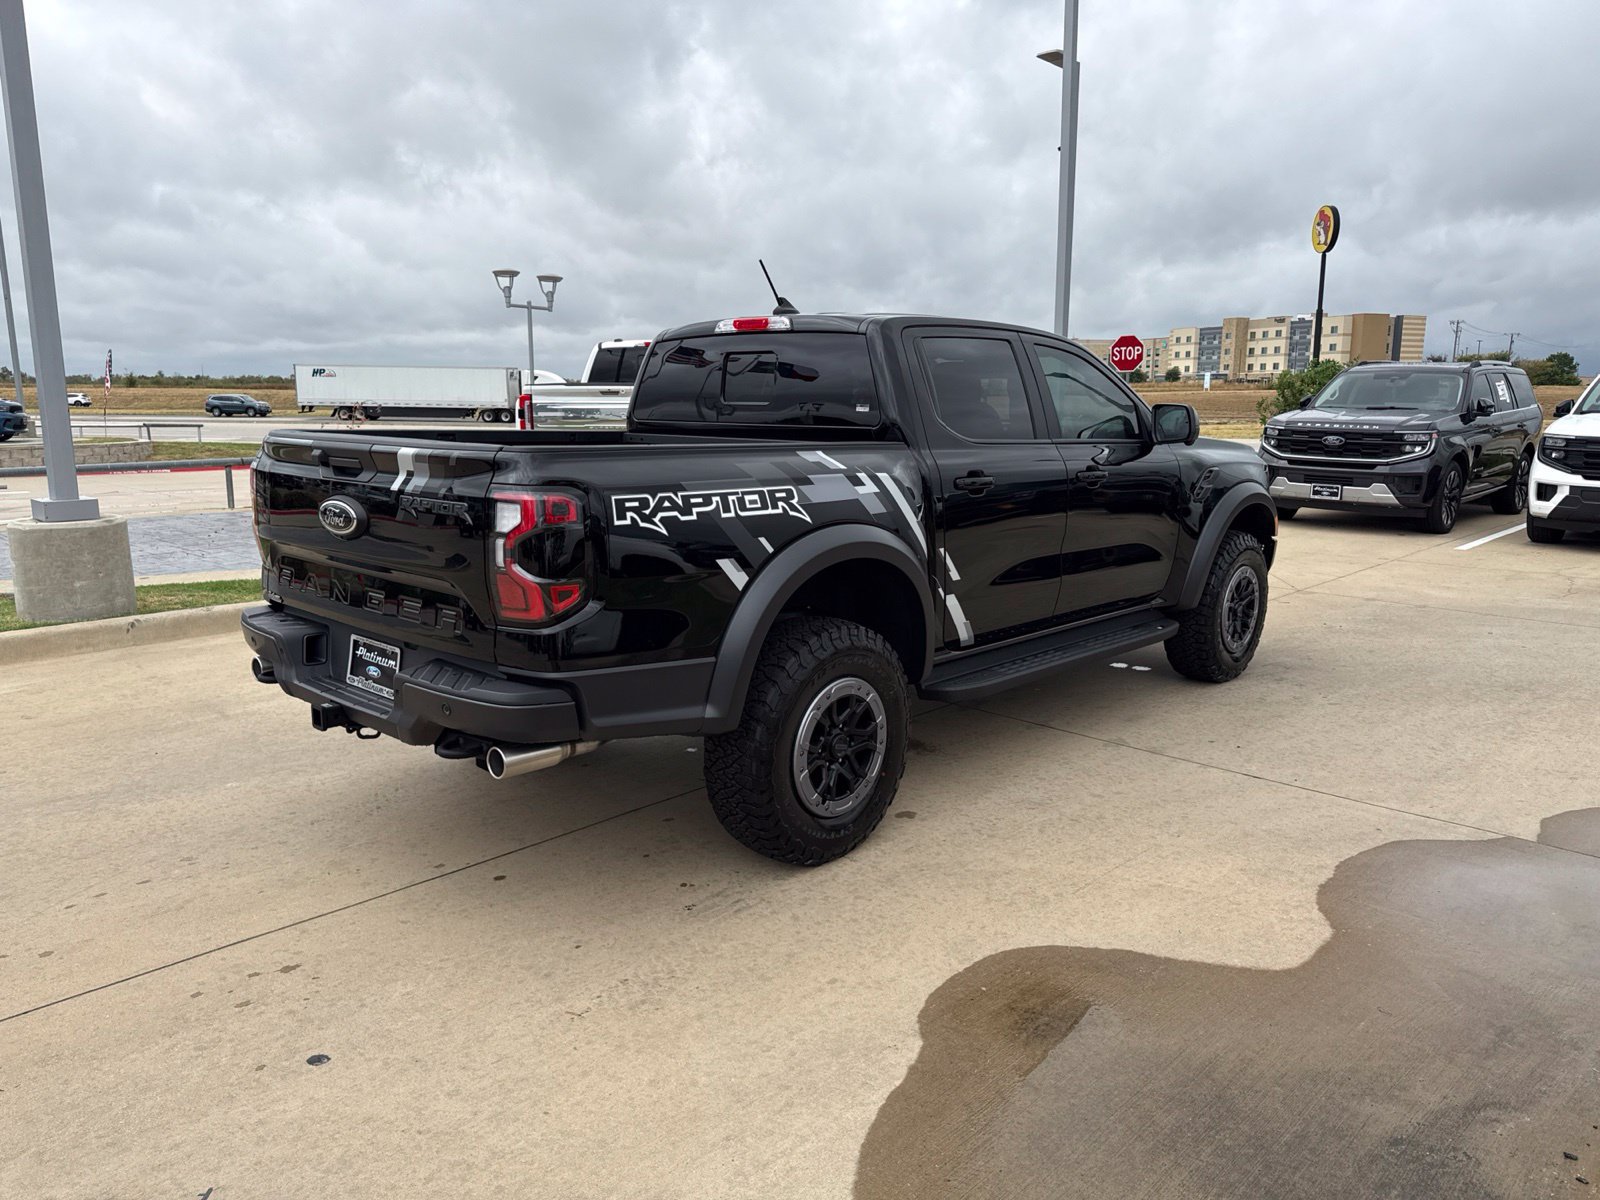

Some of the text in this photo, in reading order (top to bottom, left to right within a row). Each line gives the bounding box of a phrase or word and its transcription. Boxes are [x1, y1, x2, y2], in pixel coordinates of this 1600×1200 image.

[1113, 346, 1142, 360] STOP
[312, 368, 325, 377] HP
[324, 506, 346, 527] Ford
[399, 495, 473, 526] RAPTOR
[611, 486, 813, 536] RAPTOR
[279, 565, 463, 633] RANGER
[355, 646, 398, 669] Platinum
